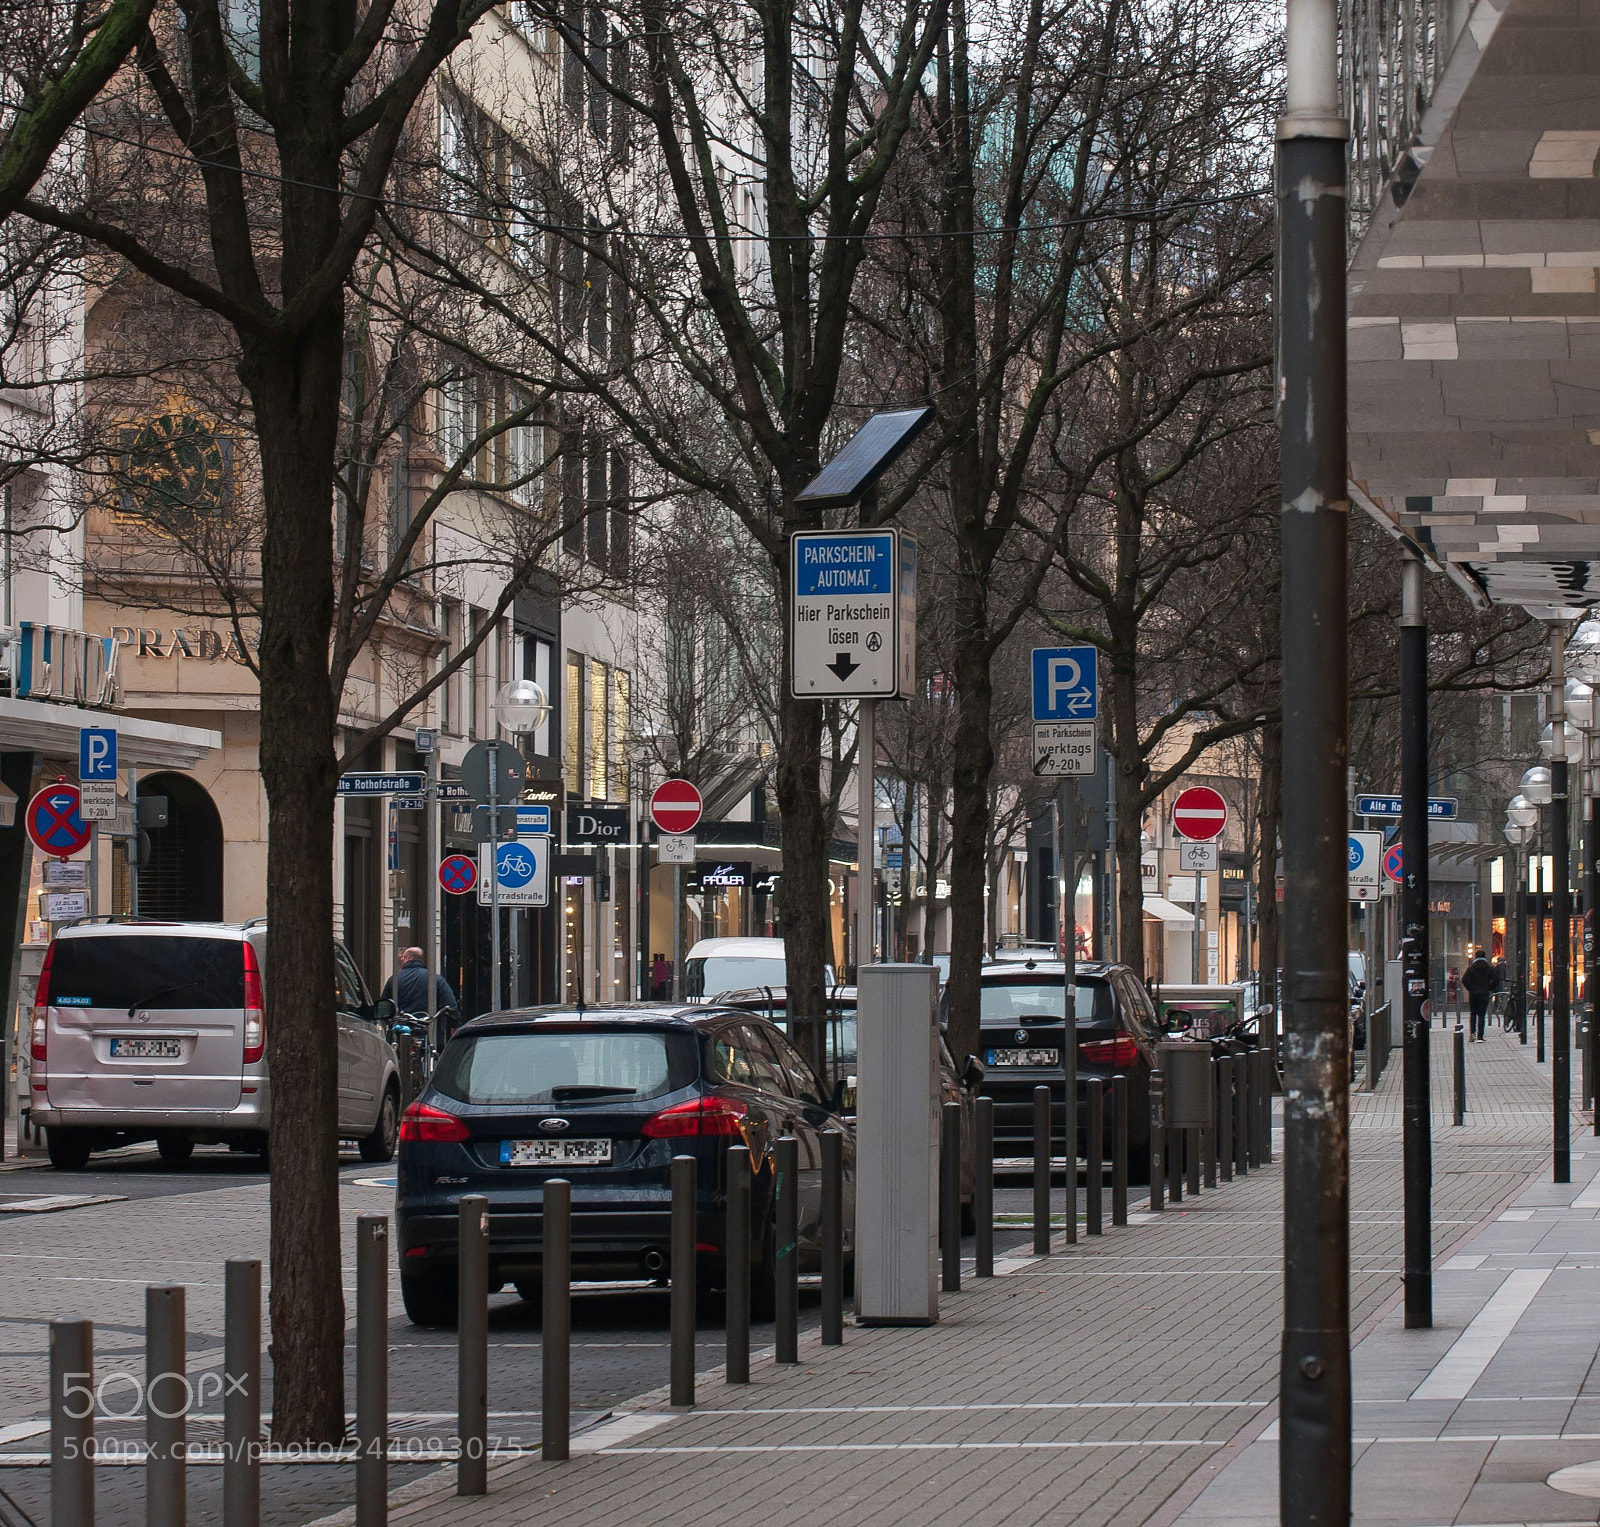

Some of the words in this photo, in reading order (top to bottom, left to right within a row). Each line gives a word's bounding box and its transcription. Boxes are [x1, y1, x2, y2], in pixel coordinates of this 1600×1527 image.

[804, 545, 884, 564] PARKSCHEIN-
[817, 569, 871, 587] AUTOMAT
[797, 605, 821, 622] Hier
[827, 603, 890, 621] Parkschein
[828, 627, 859, 644] lösen
[109, 626, 247, 663] PRADA
[1048, 657, 1081, 711] P
[1037, 728, 1050, 738] mit
[1052, 727, 1092, 738] Parkschein
[1037, 743, 1092, 756] werktags
[337, 781, 350, 790] lte
[354, 778, 411, 790] Rothofstraße
[82, 796, 115, 807] werktags
[523, 788, 558, 801] Cartier
[1369, 800, 1387, 811] Alte
[576, 815, 622, 836] Dior
[483, 891, 544, 900] Farradstraße
